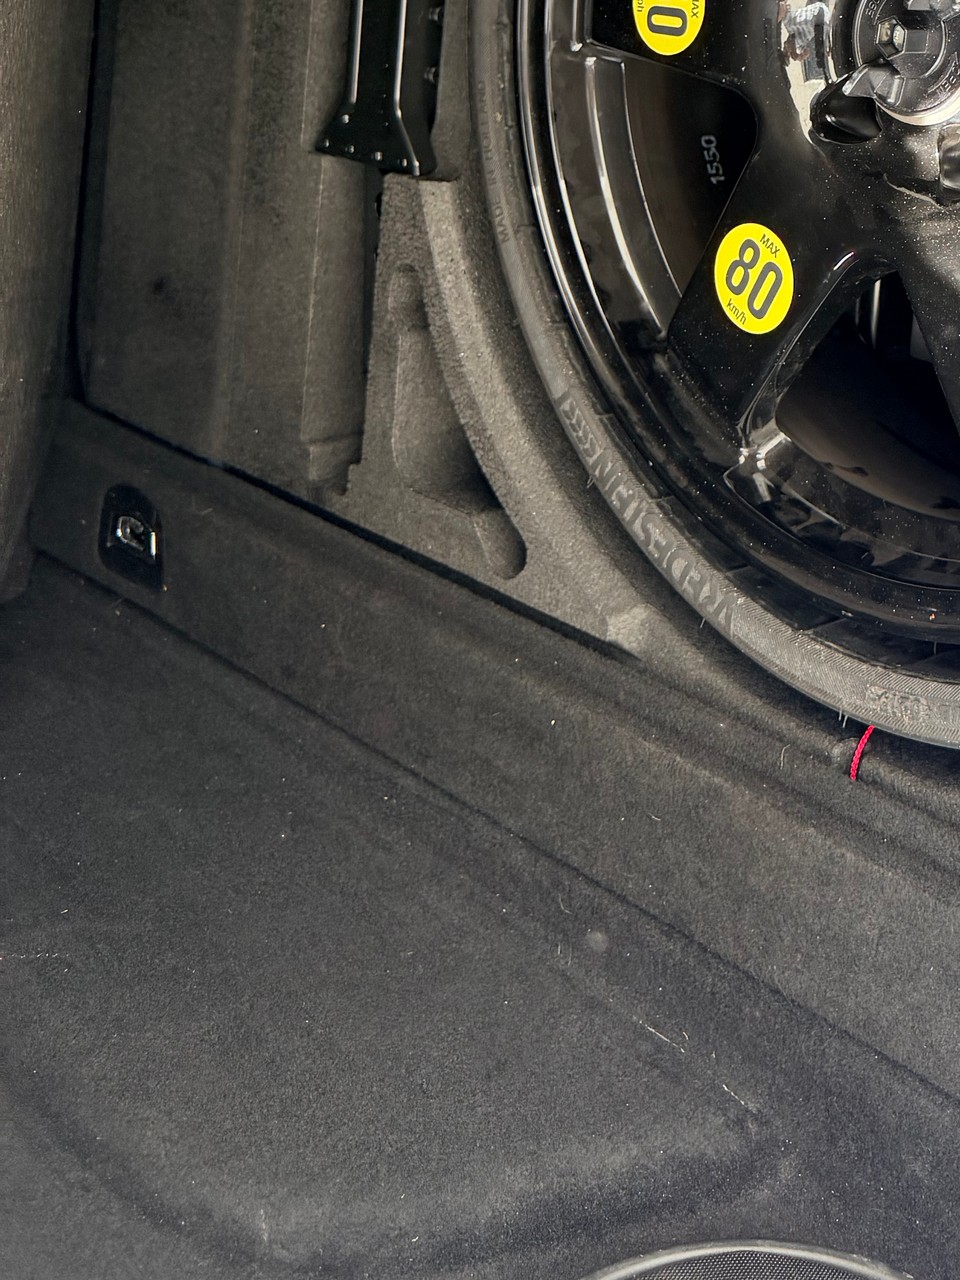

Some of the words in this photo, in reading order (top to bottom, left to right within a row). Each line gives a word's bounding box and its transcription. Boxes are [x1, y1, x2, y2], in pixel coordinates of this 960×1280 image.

[700, 133, 726, 185] 1550
[759, 233, 780, 258] MAX
[725, 238, 783, 320] 80
[726, 298, 747, 325] km/h
[592, 455, 748, 640] VREDESTEIN
